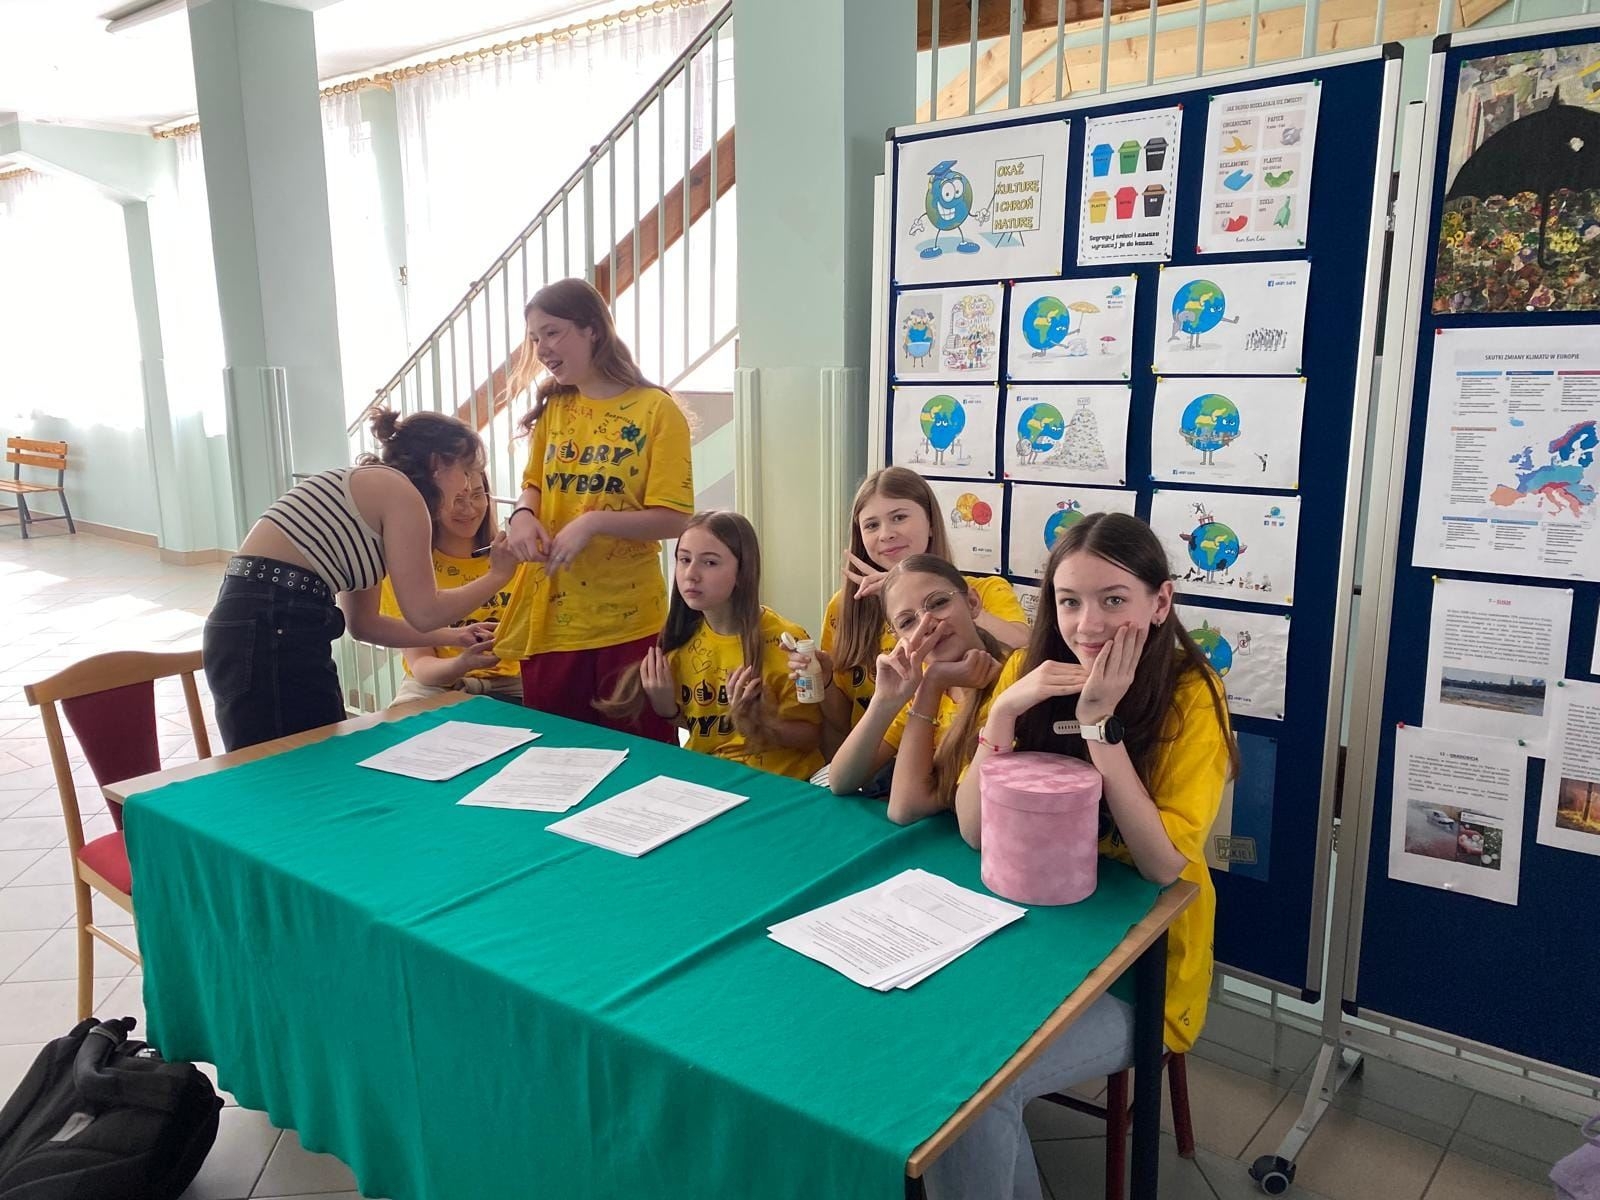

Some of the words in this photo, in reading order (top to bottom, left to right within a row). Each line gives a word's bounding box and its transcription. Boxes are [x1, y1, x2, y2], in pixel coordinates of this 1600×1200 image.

[997, 161, 1025, 178] OKAŻ
[996, 180, 1040, 195] KULTURĘ
[995, 202, 999, 212] I
[1000, 196, 1034, 212] CHROŃ
[994, 217, 1034, 230] NATURĘ
[1089, 232, 1115, 242] Segreguj
